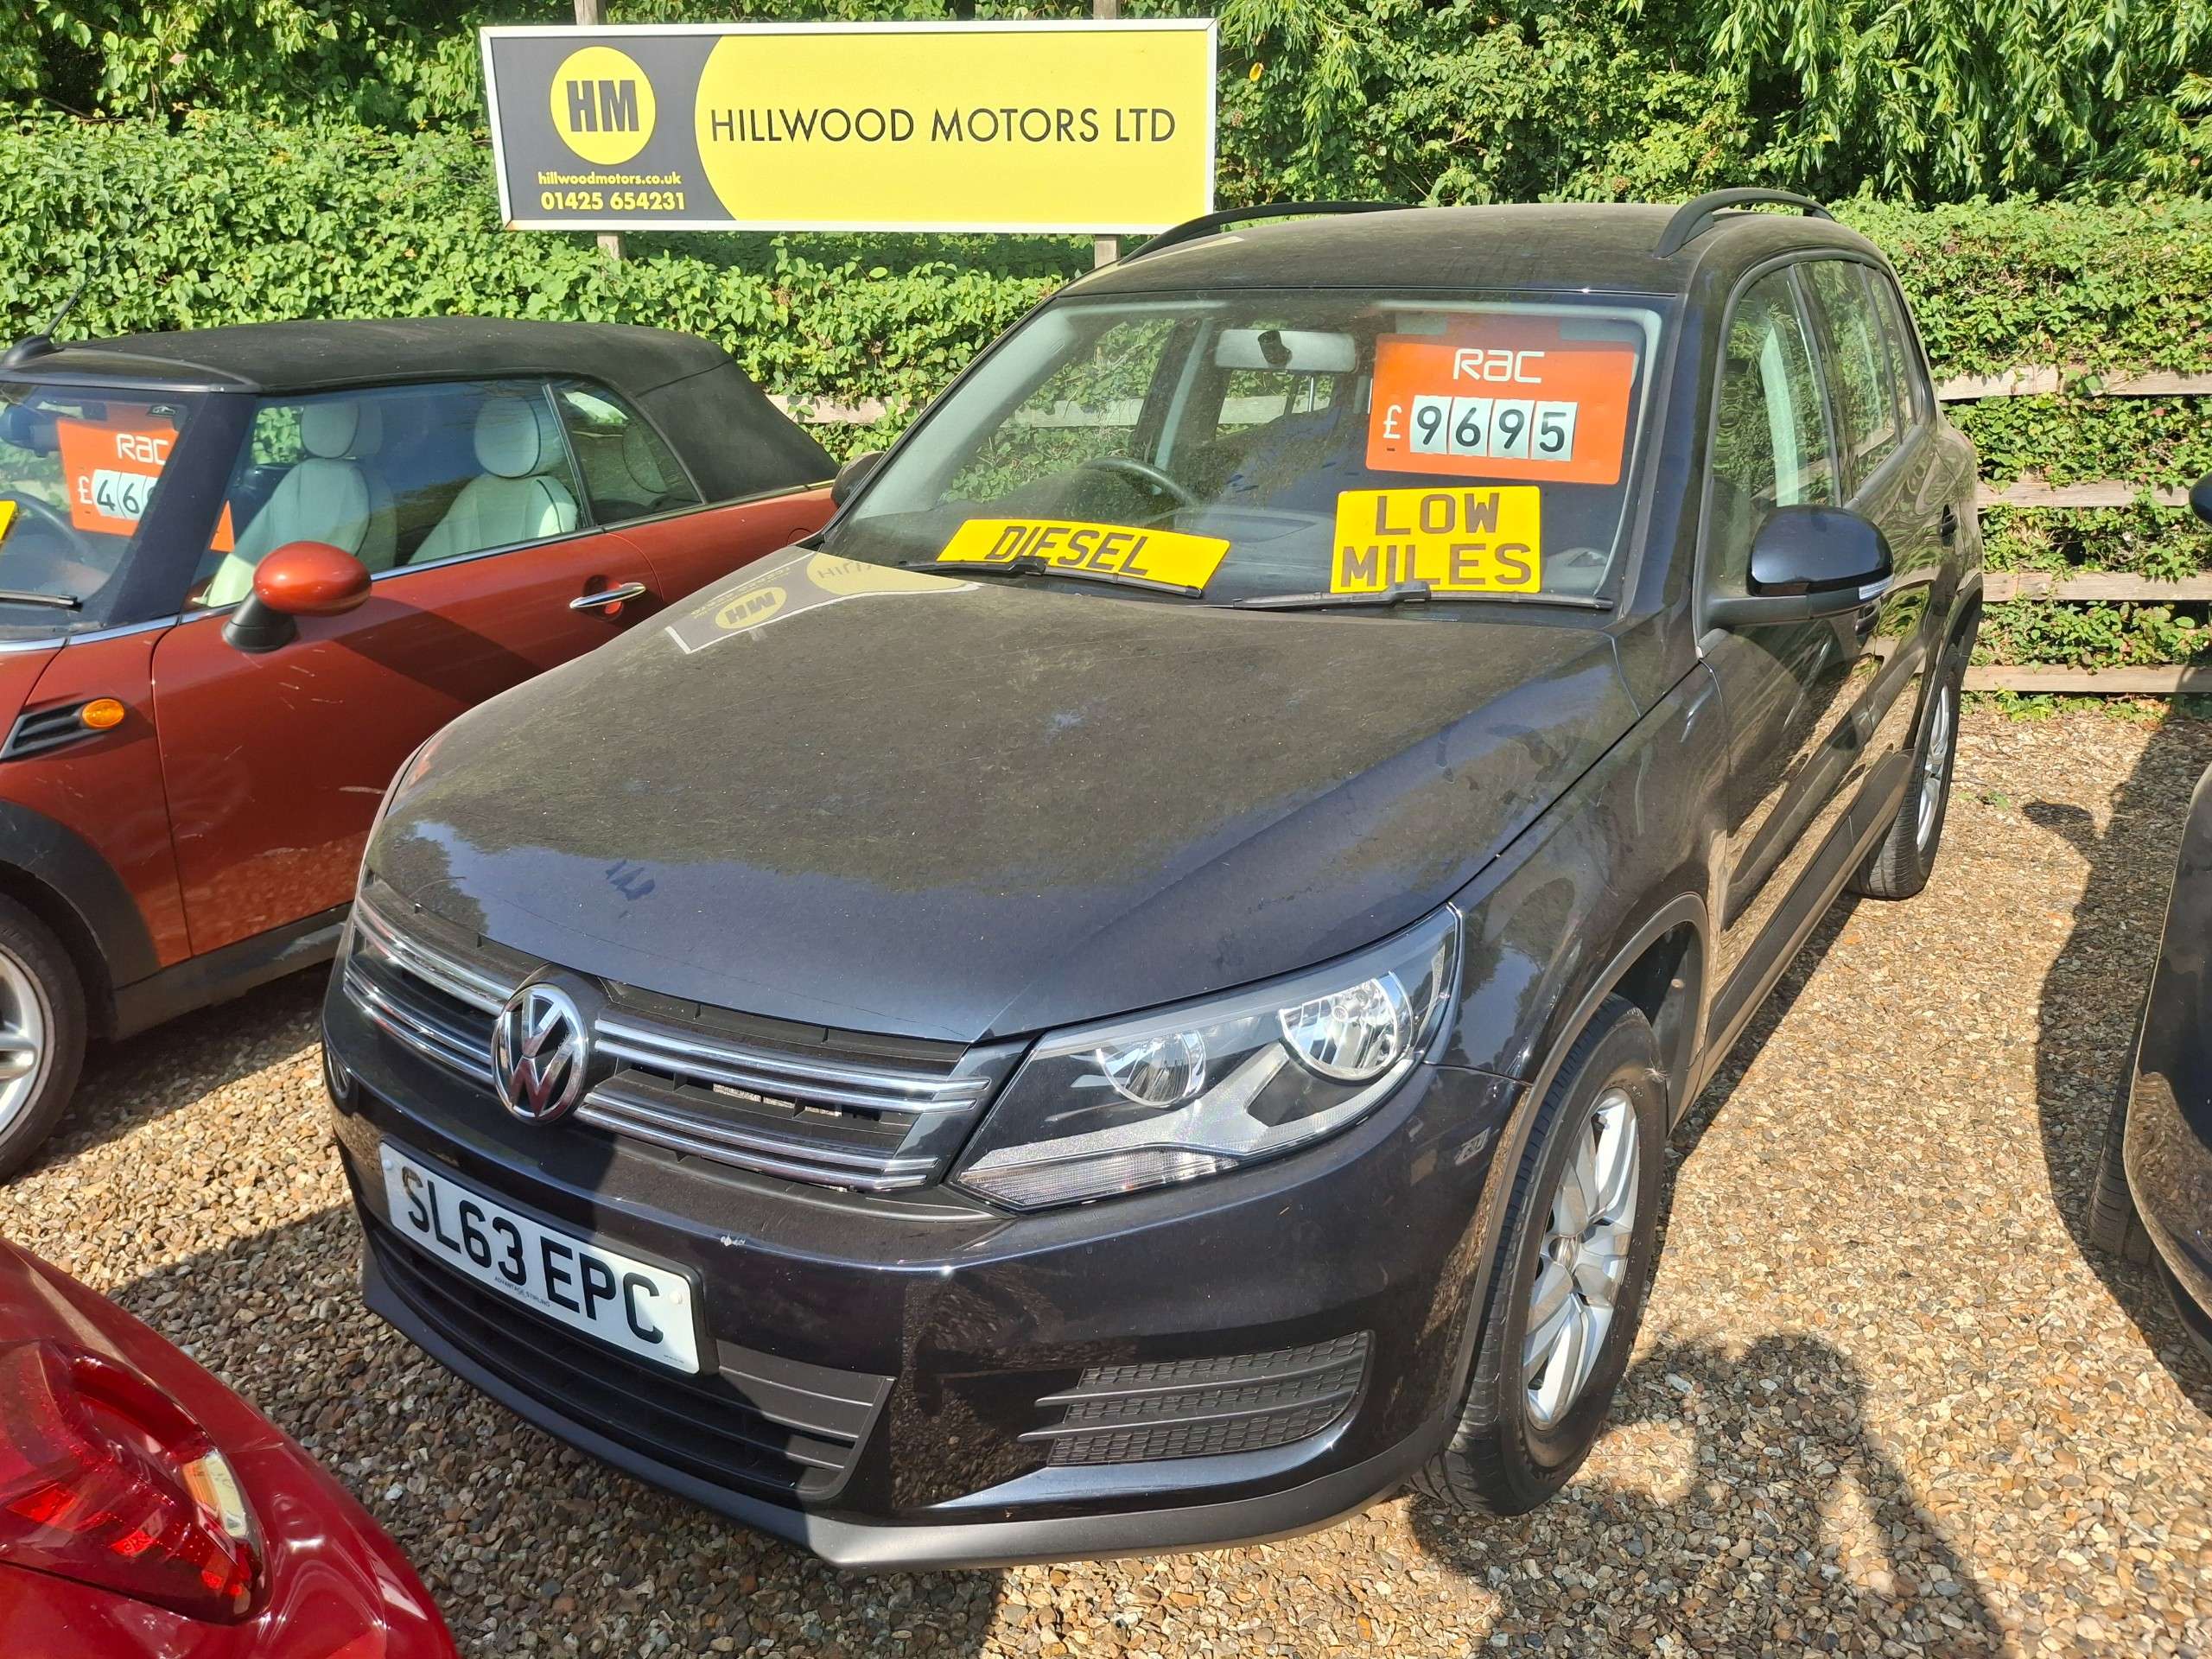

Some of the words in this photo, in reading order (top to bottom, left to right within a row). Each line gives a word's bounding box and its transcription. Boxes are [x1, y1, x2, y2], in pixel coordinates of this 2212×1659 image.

[566, 79, 639, 132] HM
[711, 108, 914, 143] HILLWOOD
[931, 107, 1099, 143] MOTORS
[1116, 108, 1176, 142] LTD
[537, 171, 683, 185] hillwoodmotors.co.uk
[541, 191, 604, 210] 01425
[609, 191, 685, 210] 654231
[1375, 493, 1500, 536] LOW
[983, 525, 1148, 576] DIESEL
[1340, 543, 1532, 588] MILES
[402, 1166, 527, 1287] SL63
[540, 1236, 664, 1344] EPC
